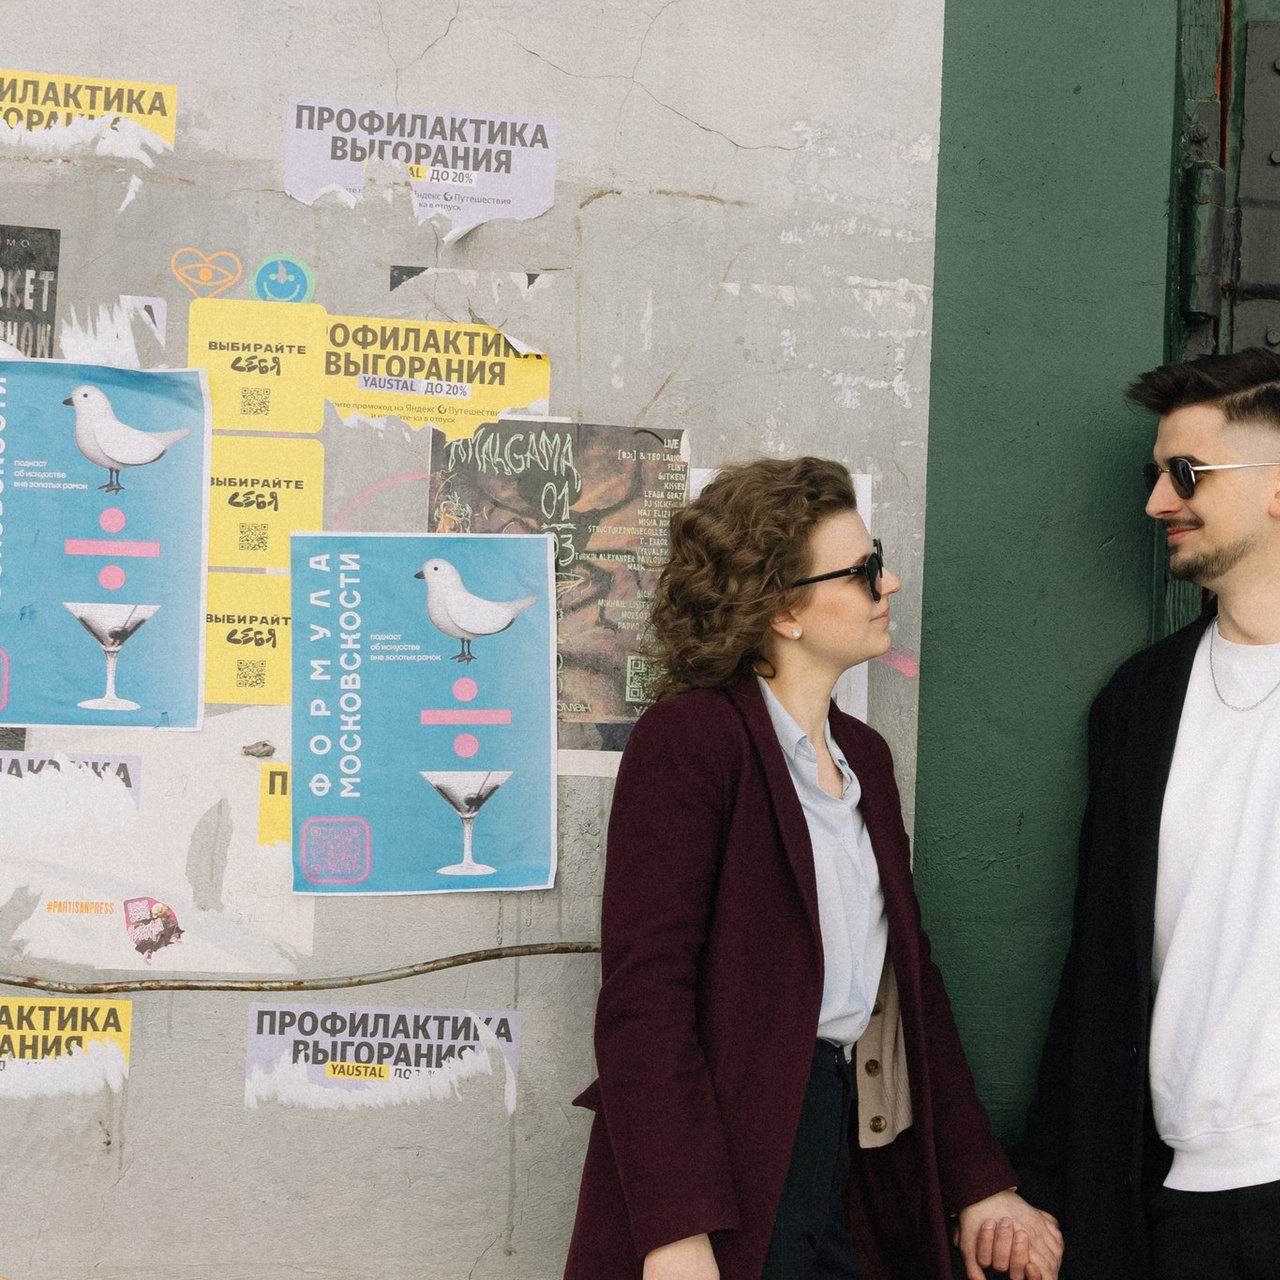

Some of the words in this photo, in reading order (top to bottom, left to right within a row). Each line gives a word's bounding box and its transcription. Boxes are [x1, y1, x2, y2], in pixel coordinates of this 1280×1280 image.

[295, 104, 549, 149] ПРОФИЛАКТИКА
[430, 169, 449, 182] ДО
[452, 171, 473, 184] 20%
[414, 190, 440, 200] ндекс
[454, 193, 511, 205] Путешествия
[208, 341, 306, 355] ВЫБИРАЙТЕ
[230, 355, 281, 376] СЕБЯ
[325, 351, 506, 386] ВЫГОРАНИЯ
[363, 376, 416, 392] YAUSTAL
[424, 382, 443, 396] ДО
[445, 383, 468, 397] 20%
[352, 403, 392, 413] промокод
[405, 404, 435, 414] Яндекс
[448, 407, 501, 418] Путешестви
[228, 490, 279, 512] СЕБЯ
[206, 613, 291, 626] ВЫБИРАЙТ
[226, 627, 277, 649] СЕБЯ
[309, 553, 332, 797] ФОРМУЛА
[339, 553, 362, 798] МОСКОВСКОСТИ
[46, 900, 116, 915] #PARTISANPRESS
[0, 1005, 122, 1032] АКТИКА
[331, 1063, 385, 1079] YAUSTAL
